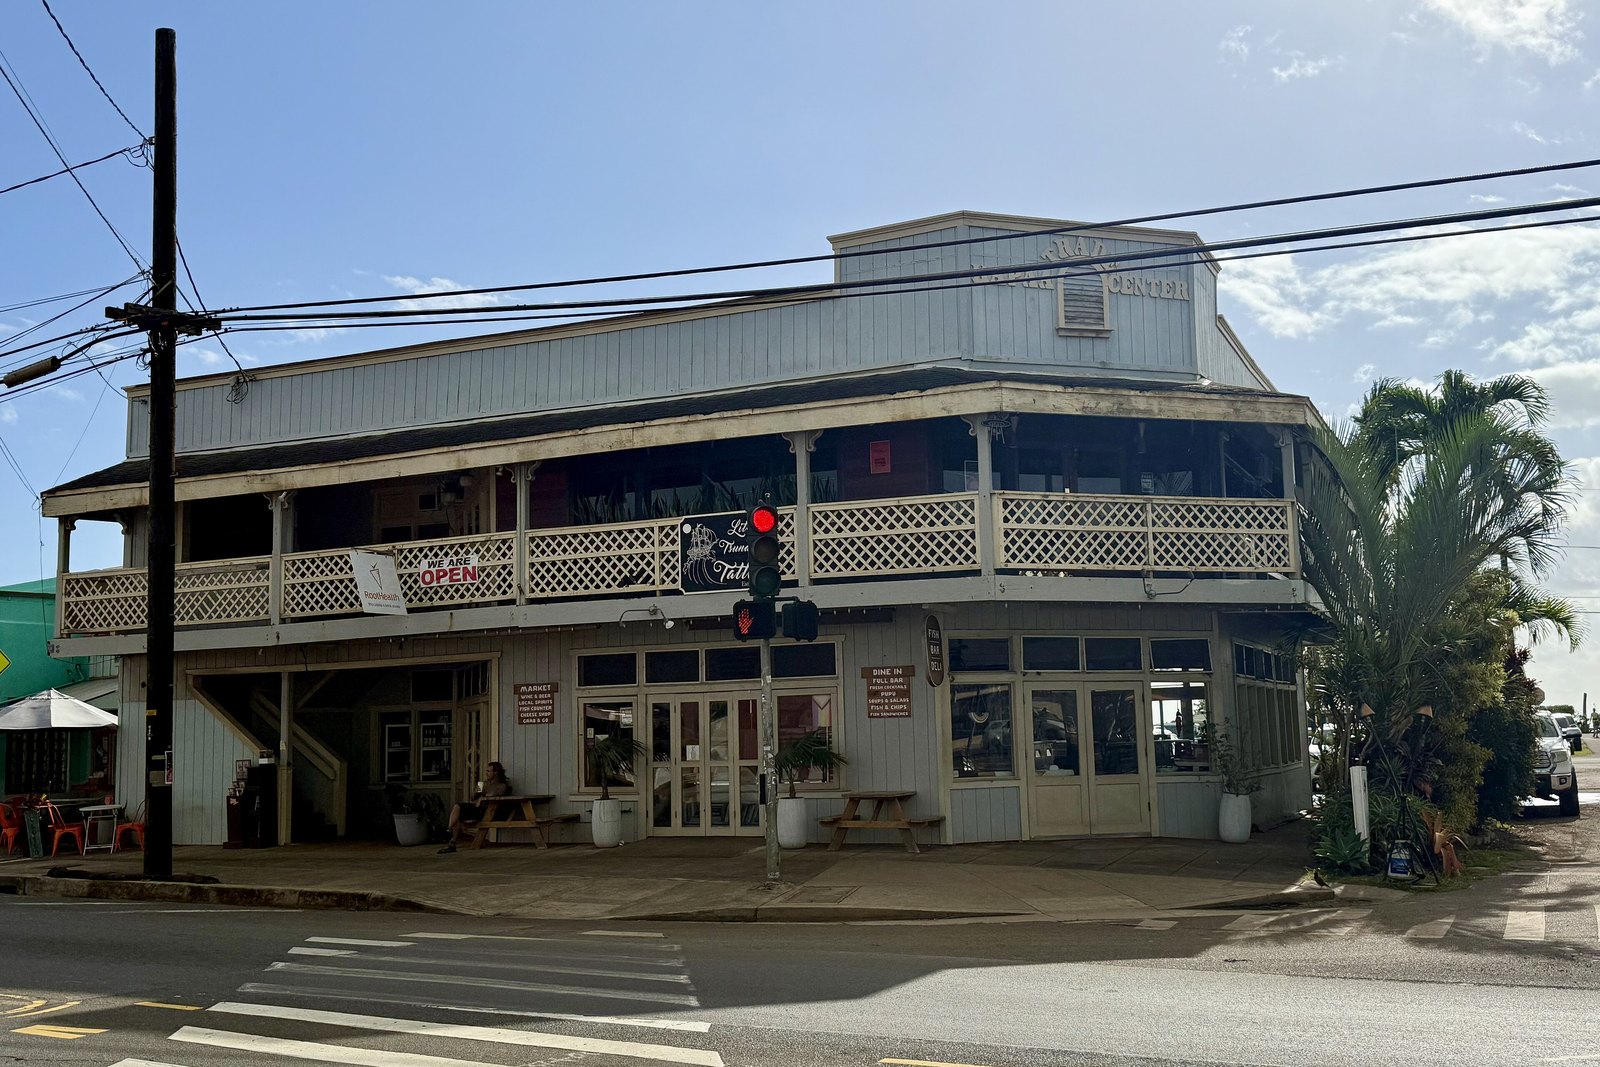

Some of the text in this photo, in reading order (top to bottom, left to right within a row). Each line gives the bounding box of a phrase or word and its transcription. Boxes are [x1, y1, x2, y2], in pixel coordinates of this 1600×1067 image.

[1107, 274, 1190, 300] CENTER
[727, 519, 748, 538] Lit
[719, 540, 748, 554] Tsuna
[427, 556, 471, 568] WE ARE
[421, 566, 477, 586] OPEN
[713, 560, 750, 582] Tatt
[928, 629, 940, 638] FISH
[930, 645, 940, 654] BAR
[930, 662, 942, 670] DELI
